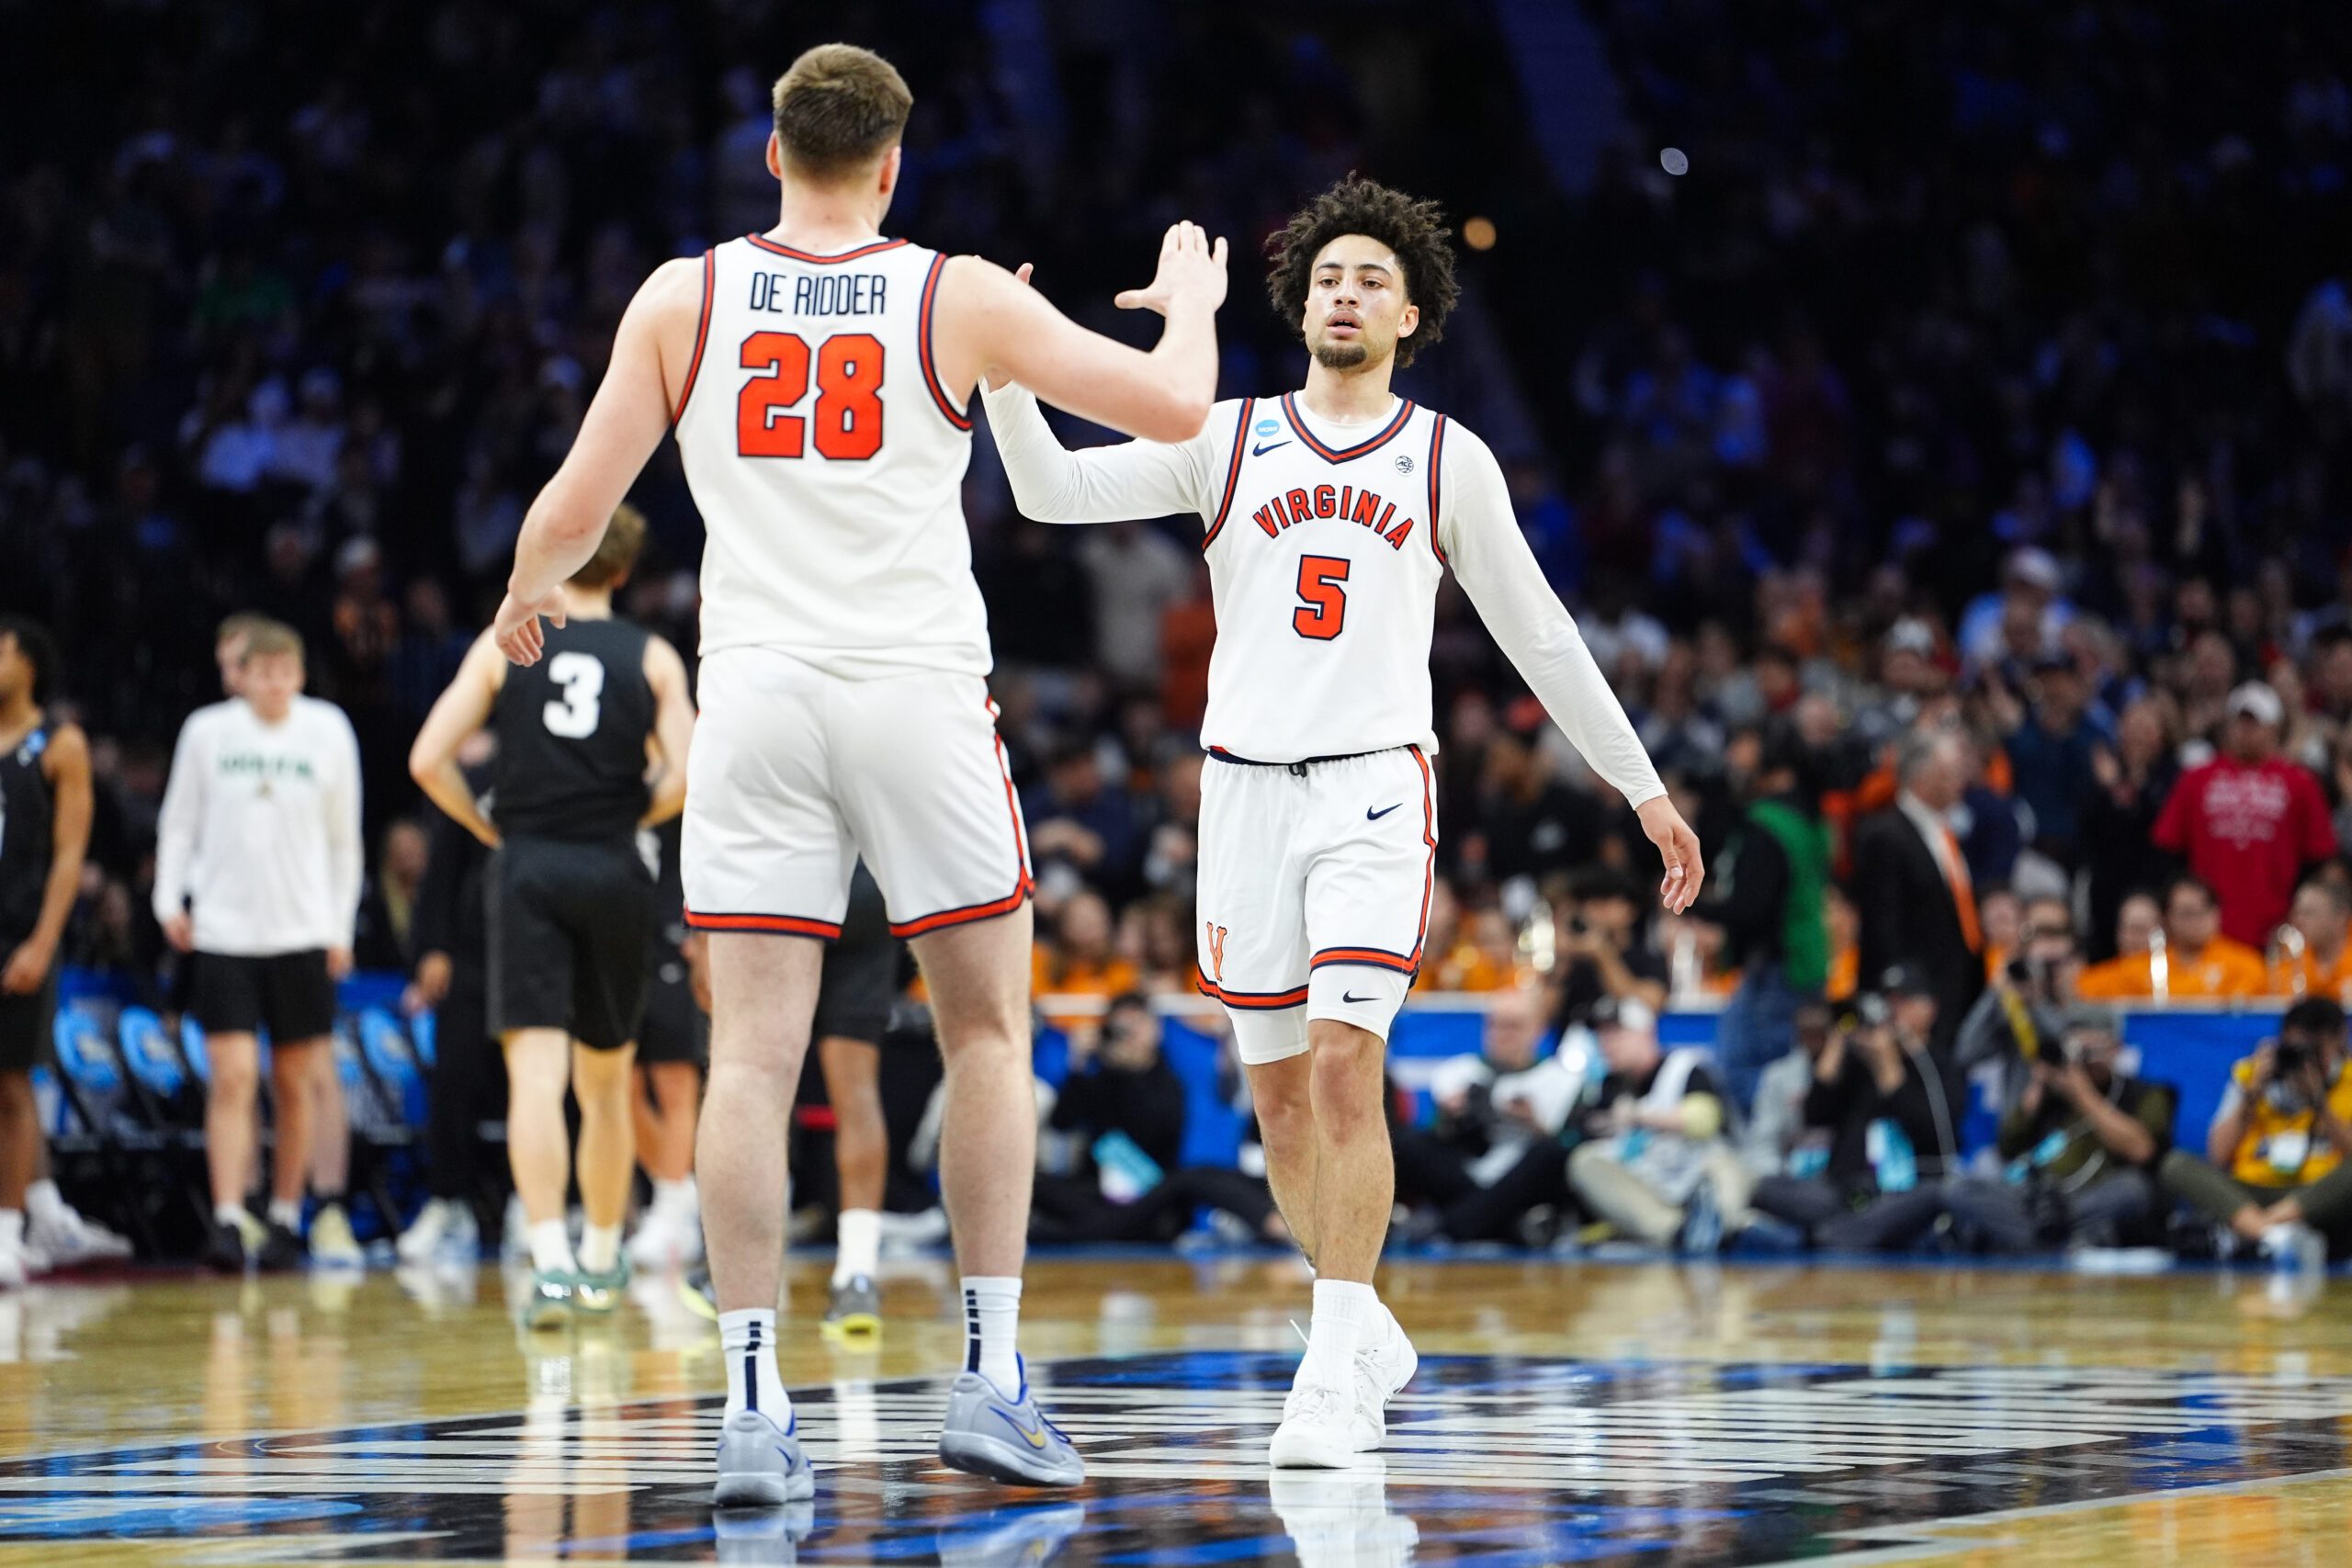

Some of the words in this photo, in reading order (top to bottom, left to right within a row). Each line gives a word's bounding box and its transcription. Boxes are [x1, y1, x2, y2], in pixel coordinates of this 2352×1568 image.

[750, 272, 786, 313] DE
[794, 275, 887, 316] RIDDER
[737, 331, 885, 460] 28
[1252, 484, 1414, 551] VIRGINIA
[1293, 554, 1351, 641] 5
[542, 651, 605, 739] 3
